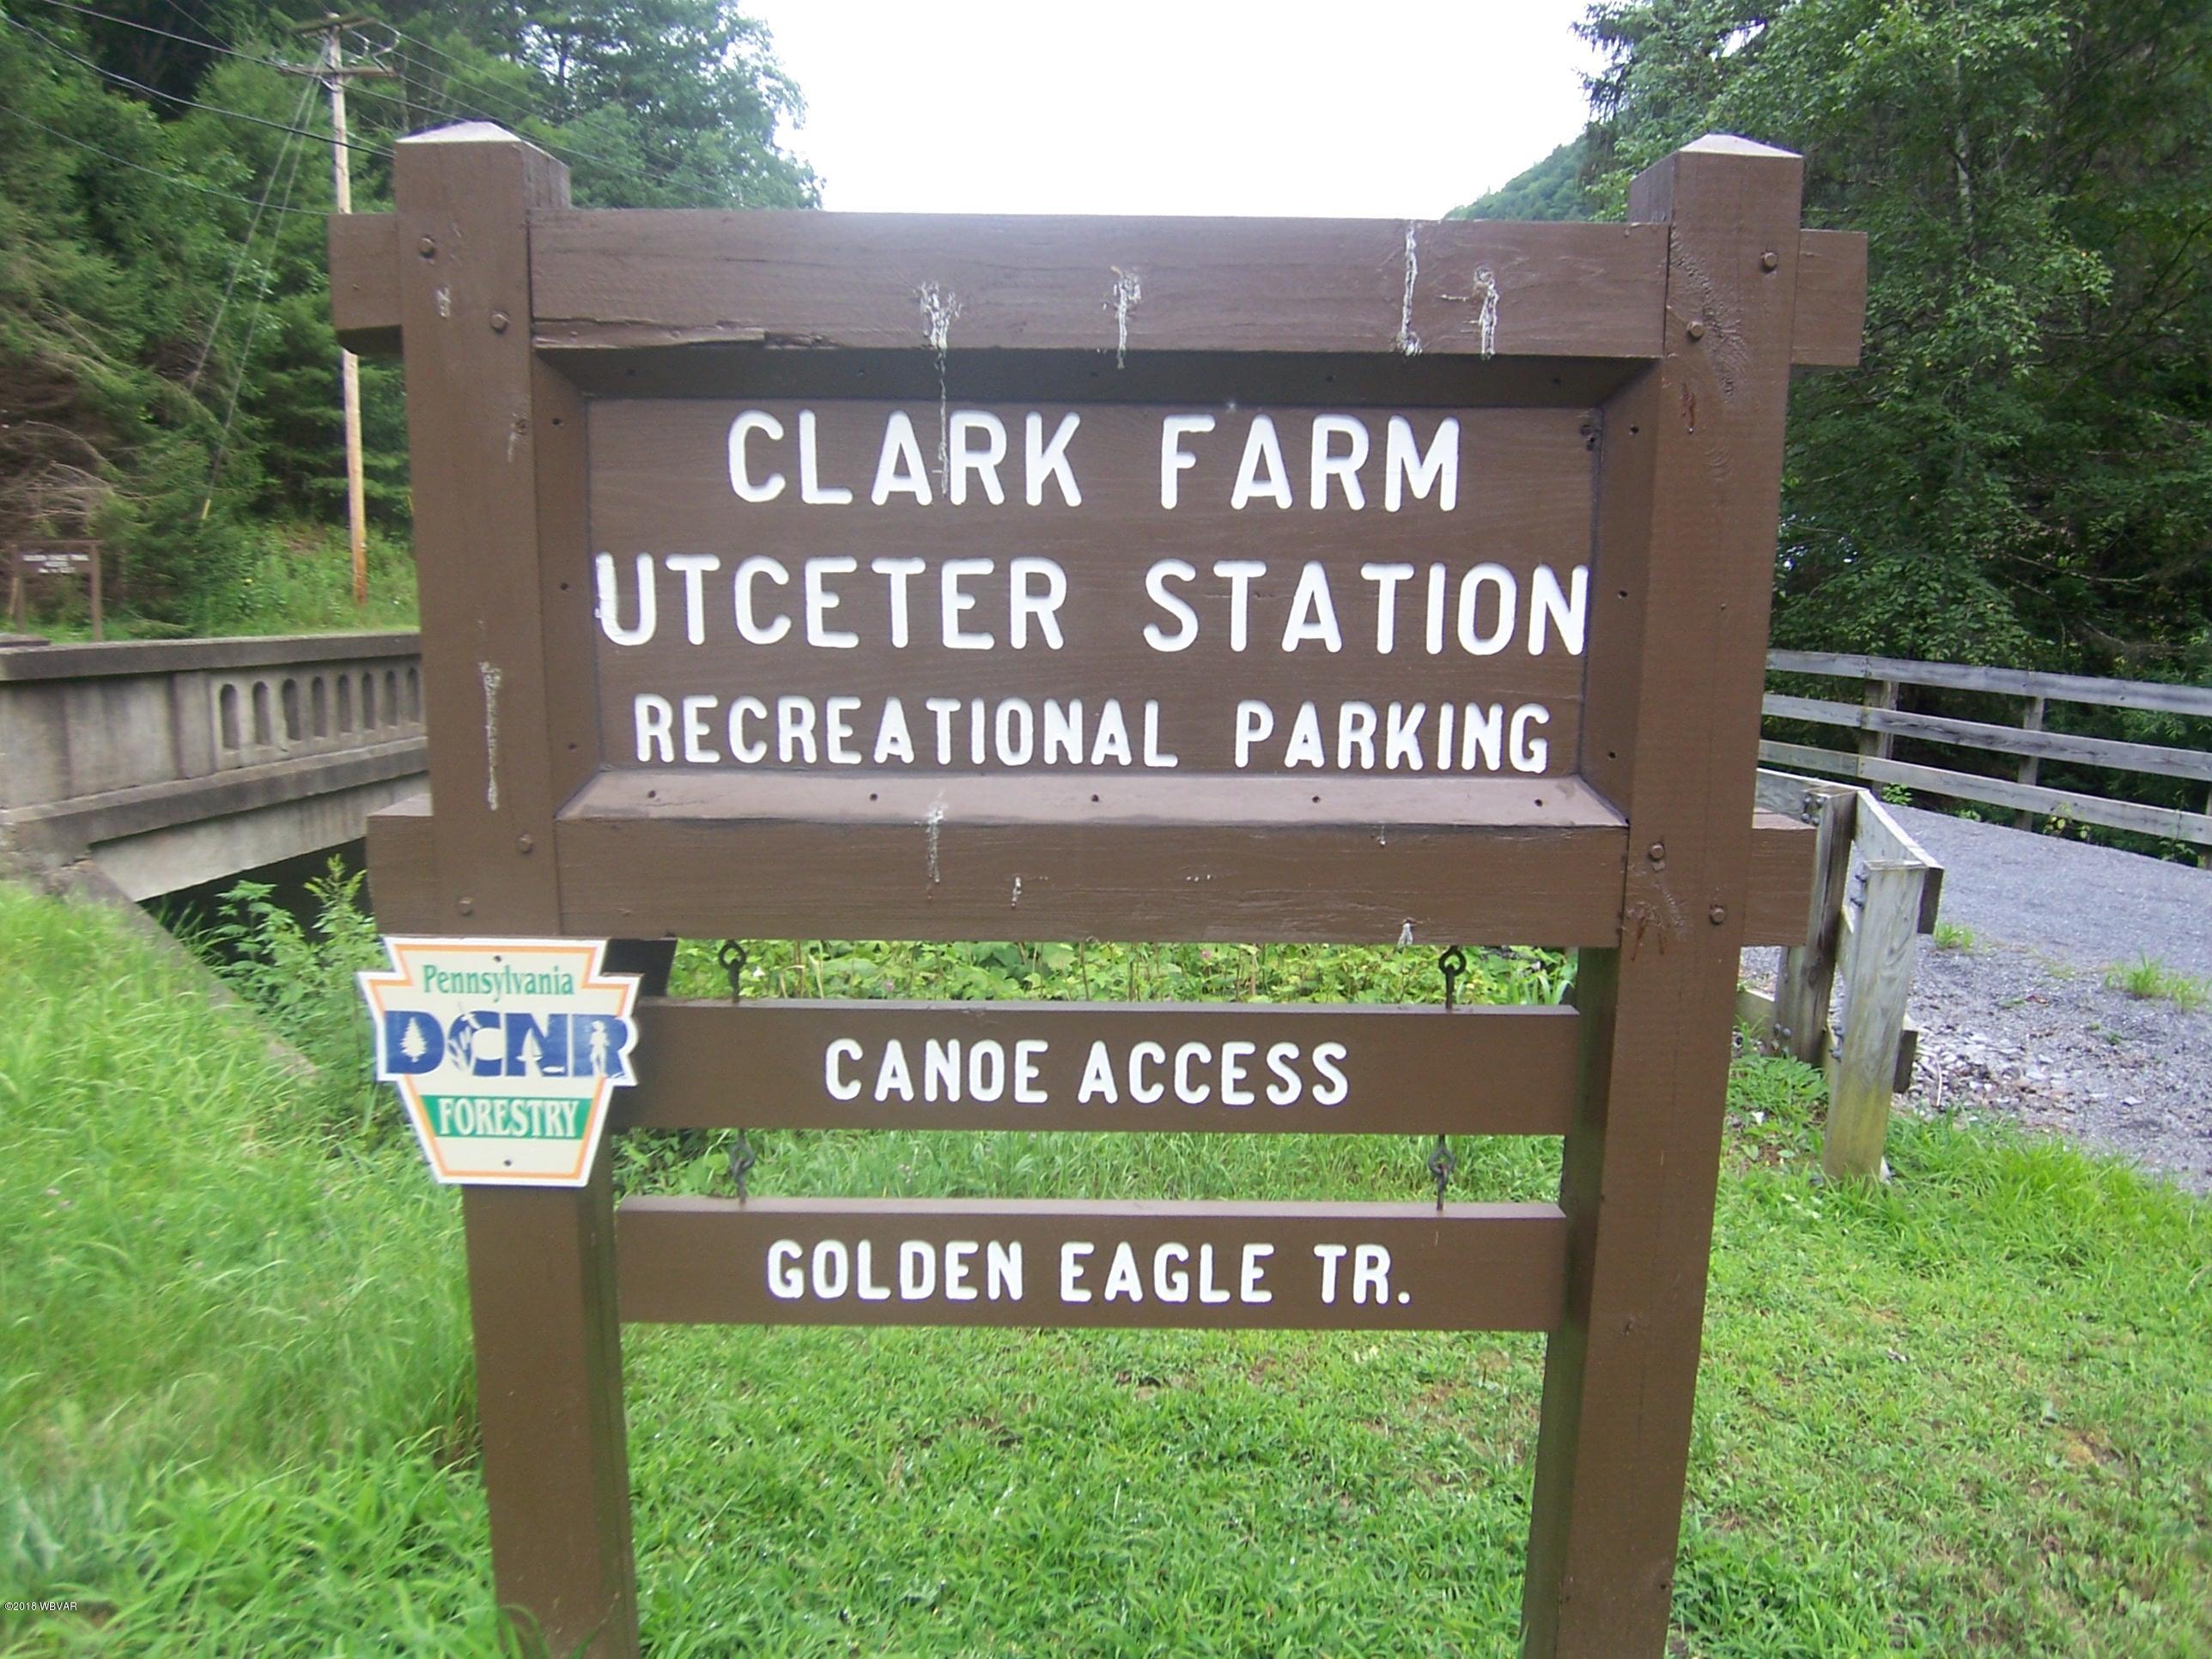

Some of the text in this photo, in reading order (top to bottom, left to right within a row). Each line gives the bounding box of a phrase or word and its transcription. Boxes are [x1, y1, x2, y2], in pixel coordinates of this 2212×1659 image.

[728, 409, 1459, 512] CLARK FARM
[595, 553, 1588, 655] UTCETER STATION
[635, 694, 1549, 773] RECREATIONAL PARKING
[422, 963, 574, 1002] Pennsylvania
[384, 1010, 629, 1079] DCNR
[826, 1039, 1347, 1105] CANOE ACCESS
[437, 1097, 580, 1137] FORESTRY
[768, 1240, 1409, 1304] GOLDEN EAGLE TR.
